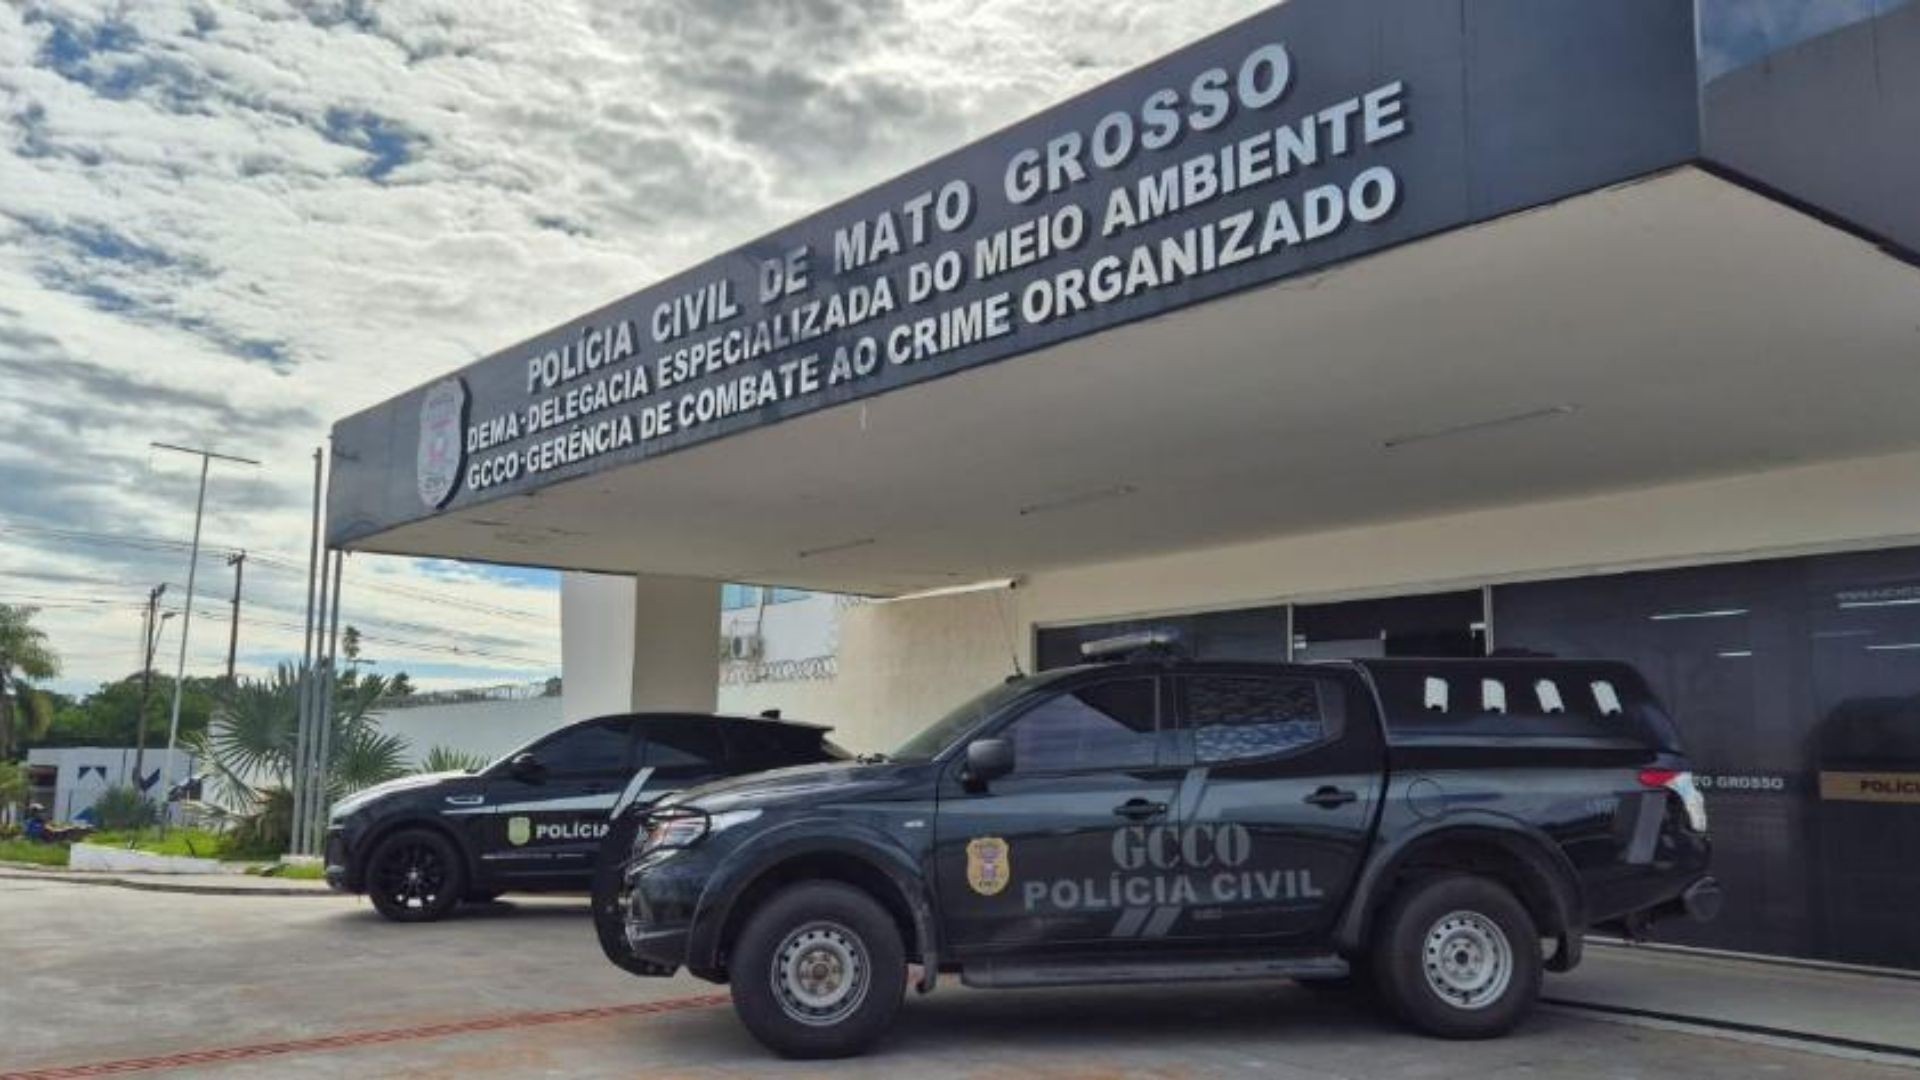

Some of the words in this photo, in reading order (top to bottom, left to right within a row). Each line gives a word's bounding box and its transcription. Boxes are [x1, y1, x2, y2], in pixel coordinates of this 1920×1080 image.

[527, 320, 633, 393] POLÍCIA
[652, 278, 737, 343] CIVIL
[759, 247, 808, 305] DE
[833, 179, 972, 275] MATO
[1003, 43, 1292, 204] GROSSO
[657, 276, 894, 388] ESPECIALIZADA
[908, 249, 962, 304] DO
[974, 203, 1086, 280] MEIO
[1102, 81, 1405, 236] AMBIENTE
[641, 402, 673, 439] DE
[678, 359, 819, 425] COMBATE
[828, 337, 877, 386] AO
[887, 292, 1011, 366] CRIME
[1021, 165, 1398, 325] ORGANIZADO
[1111, 824, 1250, 870] GCCO
[1716, 776, 1784, 789] GROSSO
[1023, 872, 1199, 911] POLÍCIA
[1211, 870, 1323, 902] CIVIL
